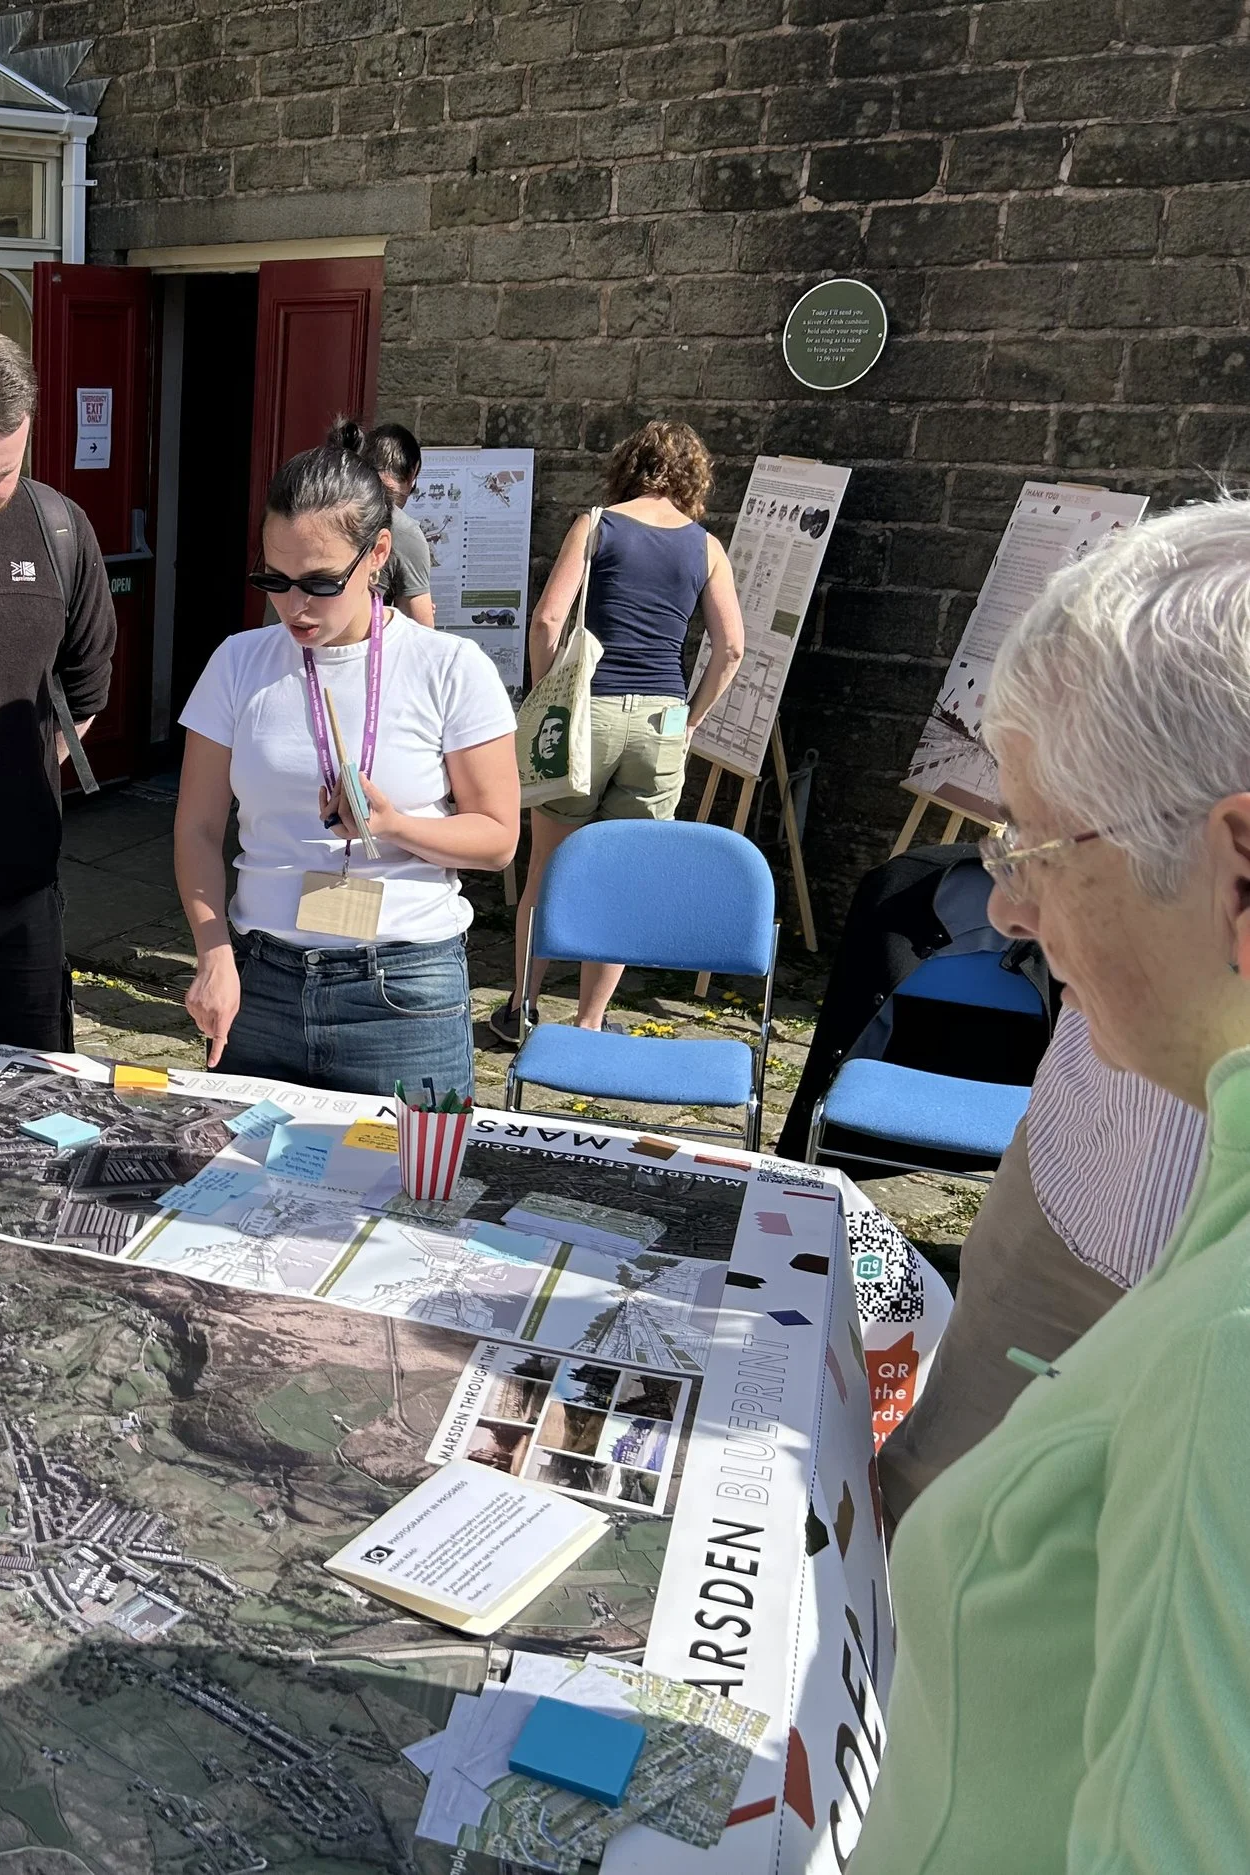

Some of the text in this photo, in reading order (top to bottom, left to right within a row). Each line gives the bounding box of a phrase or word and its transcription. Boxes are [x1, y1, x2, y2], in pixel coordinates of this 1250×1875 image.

[86, 402, 104, 415] EXIT
[87, 414, 102, 423] ONLY
[1024, 488, 1045, 499] THANK
[111, 577, 131, 593] OPEN
[0, 1063, 25, 1079] PEEL
[467, 1139, 741, 1188] MARSDEN CENTRAL FOCUS
[878, 1362, 909, 1379] QR
[874, 1383, 907, 1400] the
[437, 1344, 500, 1462] MARSDEN THROUGH TIME
[716, 1333, 790, 1506] BLUEPRINT
[872, 1404, 904, 1422] rds
[386, 1509, 432, 1544] PHOTOGRAPHY
[436, 1480, 468, 1504] PROGRESS
[68, 1566, 92, 1592] Bank
[83, 1563, 112, 1597] Bottom
[99, 1580, 119, 1601] Mill
[683, 1517, 766, 1699] ARSDEN
